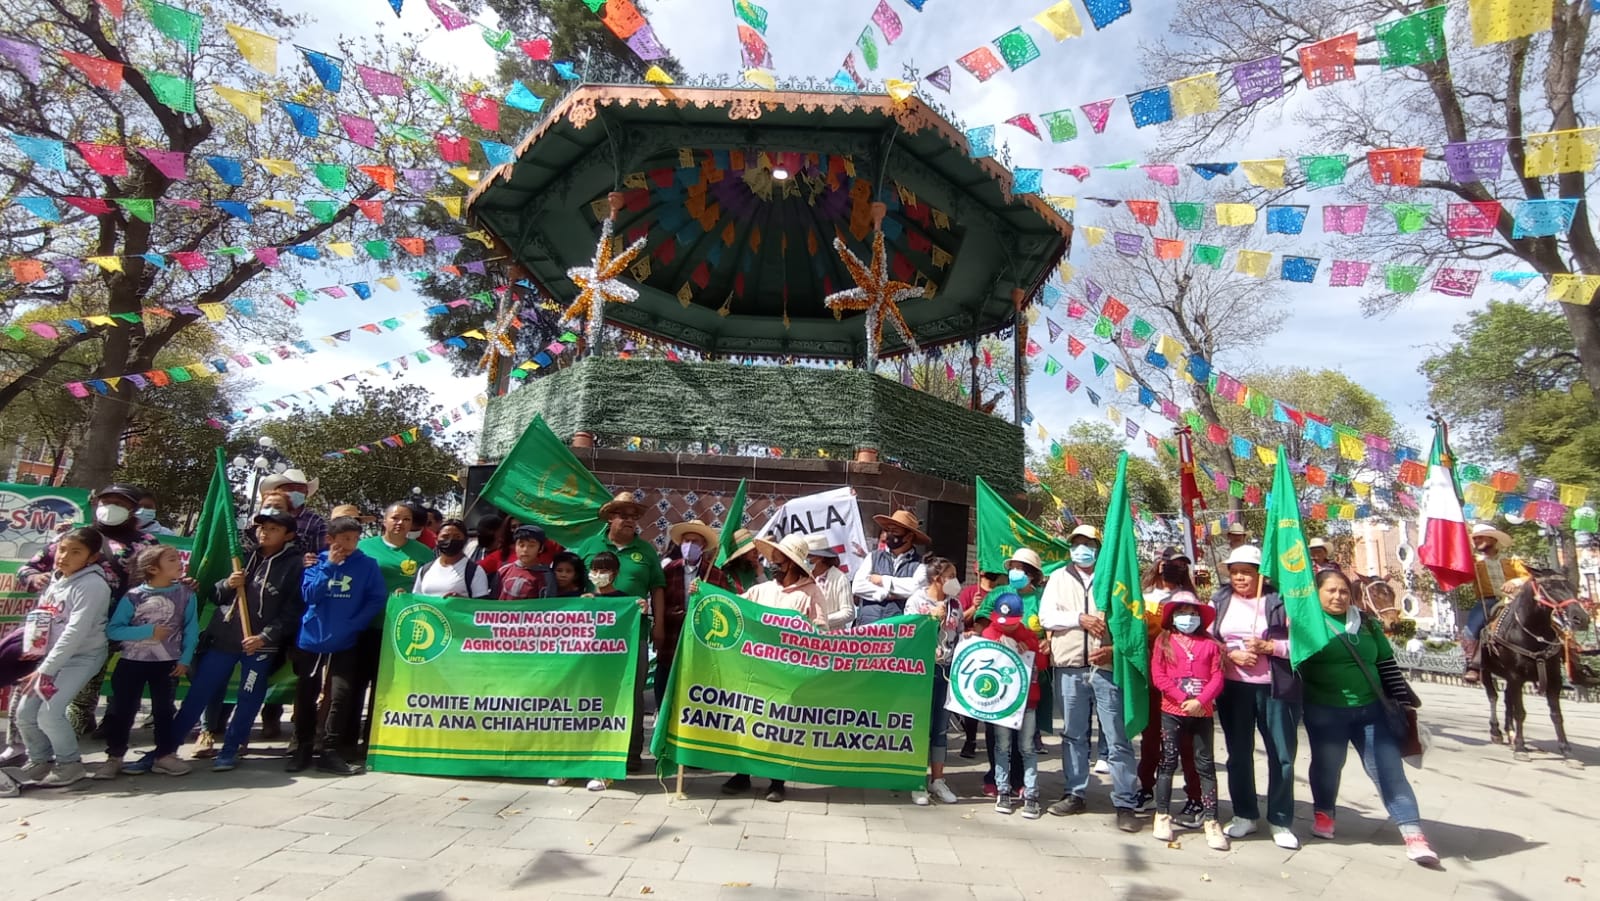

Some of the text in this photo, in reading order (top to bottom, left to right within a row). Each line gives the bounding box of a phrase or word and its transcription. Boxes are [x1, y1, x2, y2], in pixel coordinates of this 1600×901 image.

[768, 505, 846, 538] YALA
[474, 612, 615, 625] UNION NACIONAL DE
[492, 626, 595, 638] TRABAJADORES
[899, 625, 915, 638] DE
[461, 638, 627, 653] AGRICOLAS DE TLAXCALA
[780, 632, 894, 655] TRABAJADORES
[741, 642, 926, 675] AGRICOLAS DE TLAXCALA
[407, 694, 602, 712] COMITE MUNICIPAL DE
[688, 685, 913, 730] COMITE MUNICIPAL DE
[383, 711, 626, 731] SANTA ANA CHIAHUTEMPAN
[681, 707, 914, 752] SANTA CRUZ TLAXCALA
